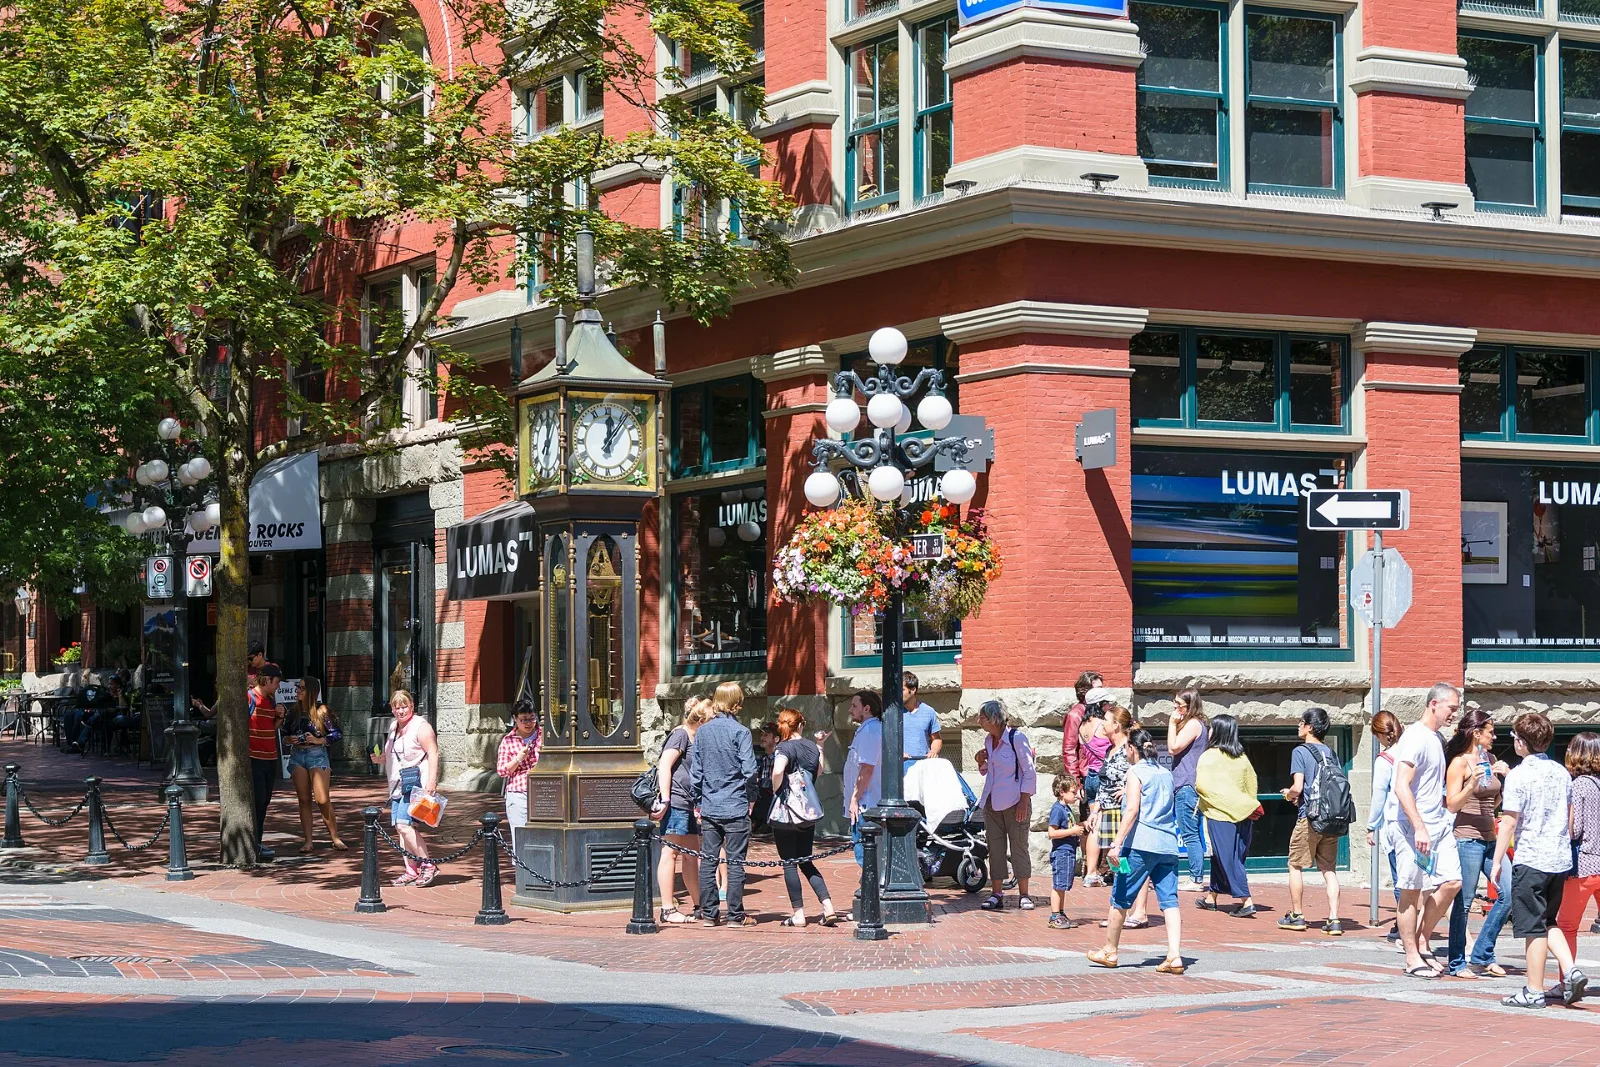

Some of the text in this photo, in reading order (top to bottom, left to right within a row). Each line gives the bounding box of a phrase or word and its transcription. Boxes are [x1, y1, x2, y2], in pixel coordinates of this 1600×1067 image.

[1084, 434, 1106, 446] LUMAS
[1222, 470, 1317, 498] LUMAS
[718, 500, 767, 527] LUMAS
[256, 522, 304, 538] ROCKS
[249, 540, 272, 548] OUVER
[914, 540, 928, 555] TER
[456, 539, 519, 579] LUMAS
